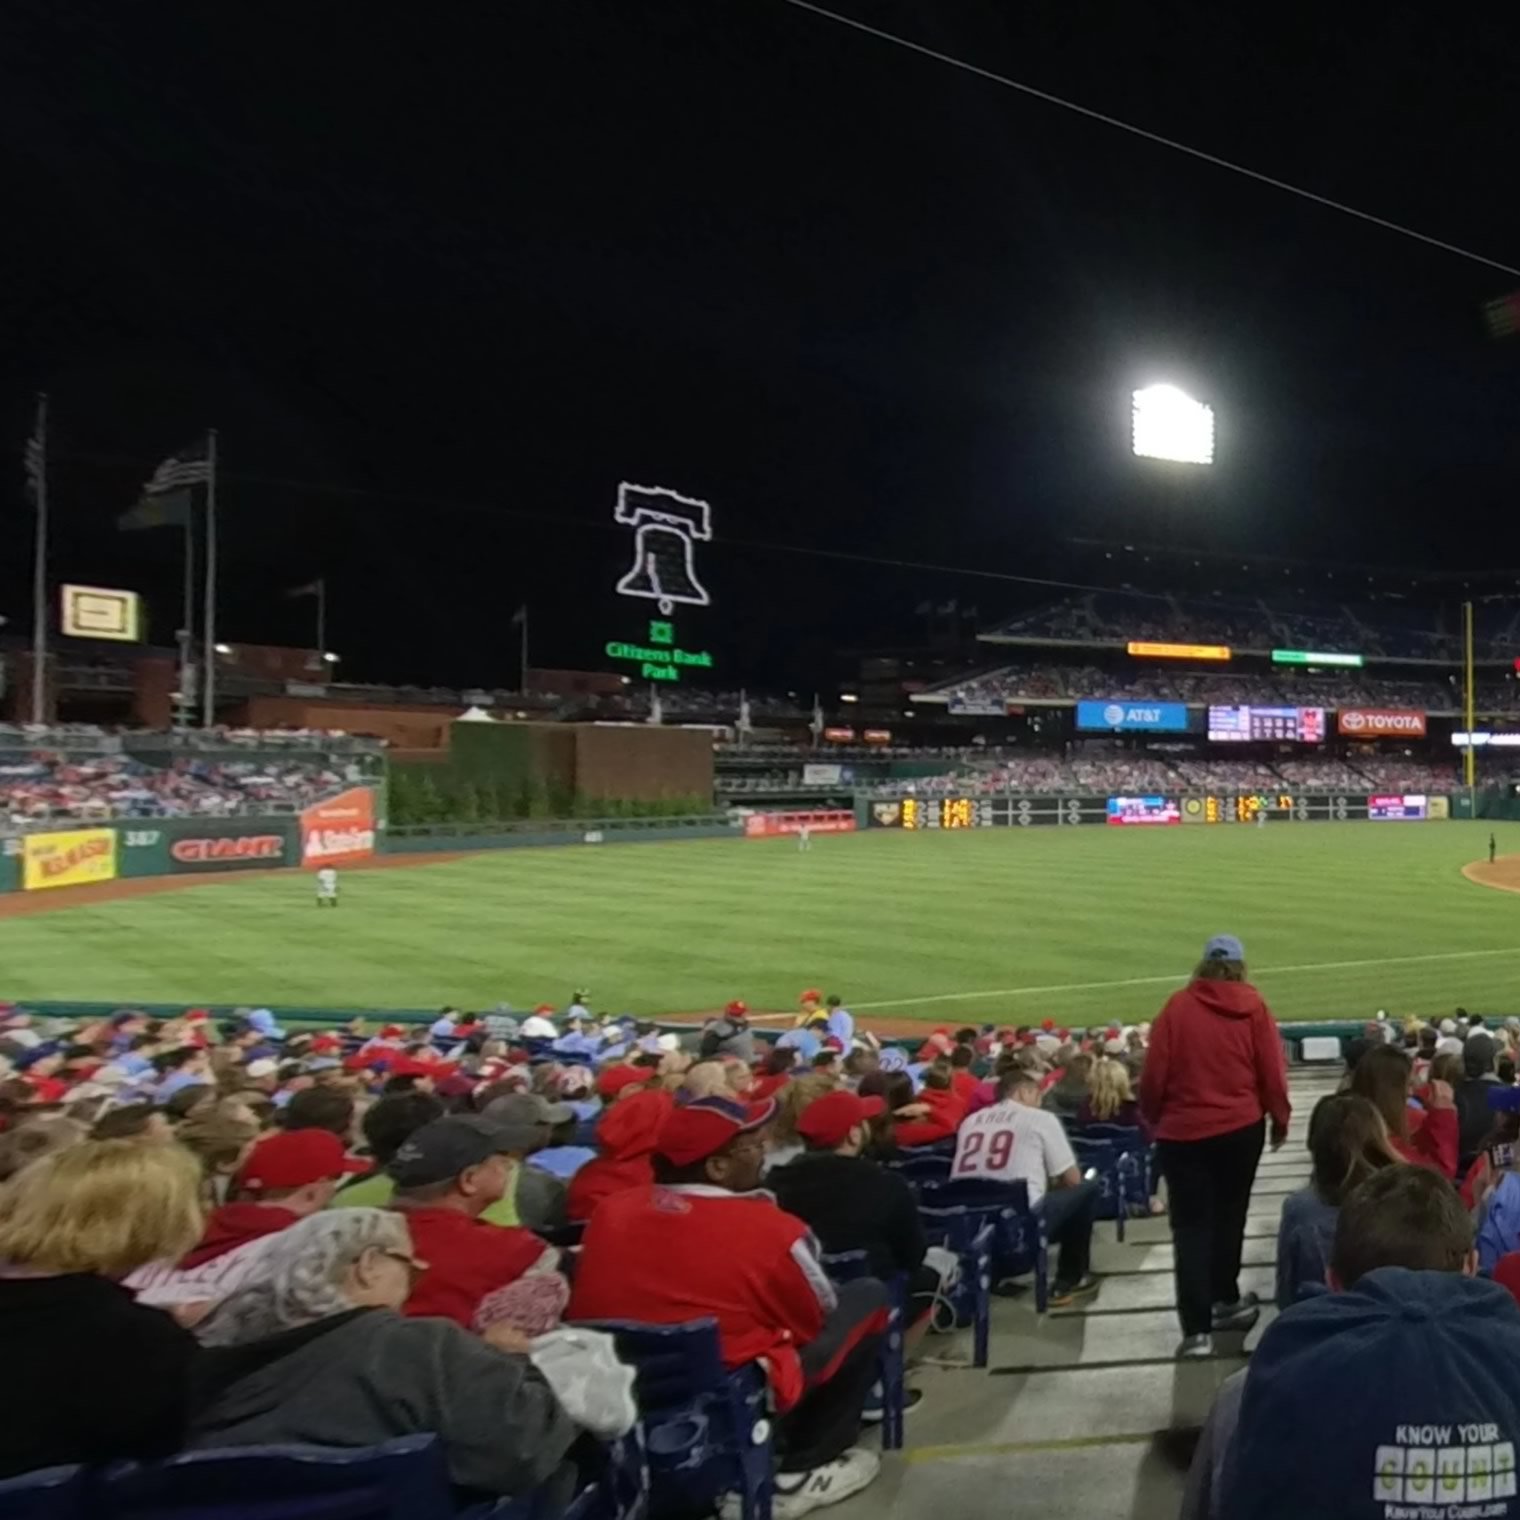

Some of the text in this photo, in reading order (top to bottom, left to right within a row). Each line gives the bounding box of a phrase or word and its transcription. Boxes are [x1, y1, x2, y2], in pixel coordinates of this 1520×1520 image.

[606, 642, 713, 667] Citizens Bank
[642, 663, 679, 680] Park
[1126, 709, 1162, 722] AT&T
[1365, 714, 1423, 729] TOYOTA
[171, 836, 284, 862] GIANT
[957, 1129, 1015, 1173] 29
[1396, 1423, 1499, 1445] KNOW YOUR
